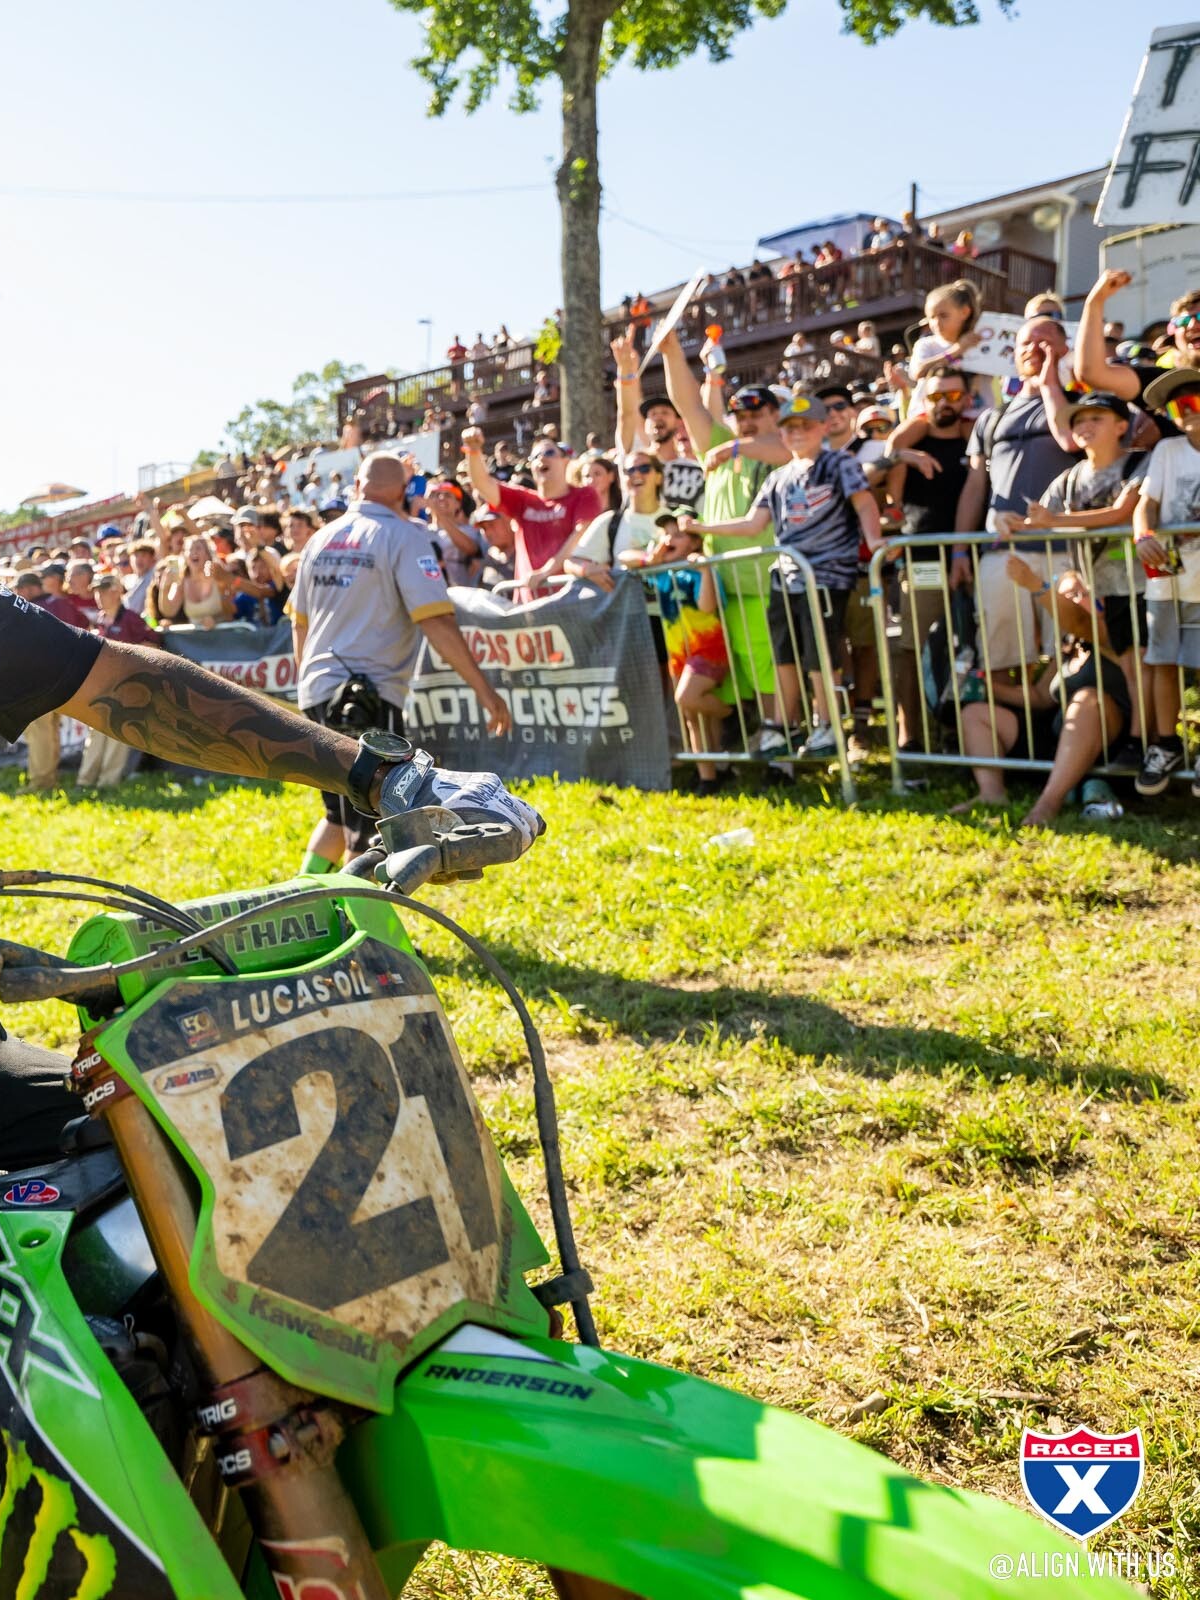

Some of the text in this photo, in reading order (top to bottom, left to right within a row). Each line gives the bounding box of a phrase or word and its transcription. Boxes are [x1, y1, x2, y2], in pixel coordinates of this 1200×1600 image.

[452, 630, 565, 666] CAS OIL
[210, 661, 268, 690] UCAS
[148, 912, 329, 970] RETHAL
[231, 962, 374, 1031] LUCAS OIL
[221, 1011, 499, 1309] 21
[11, 1180, 47, 1203] VP
[249, 1293, 378, 1363] Kawasaki
[424, 1364, 596, 1401] ANDERSON
